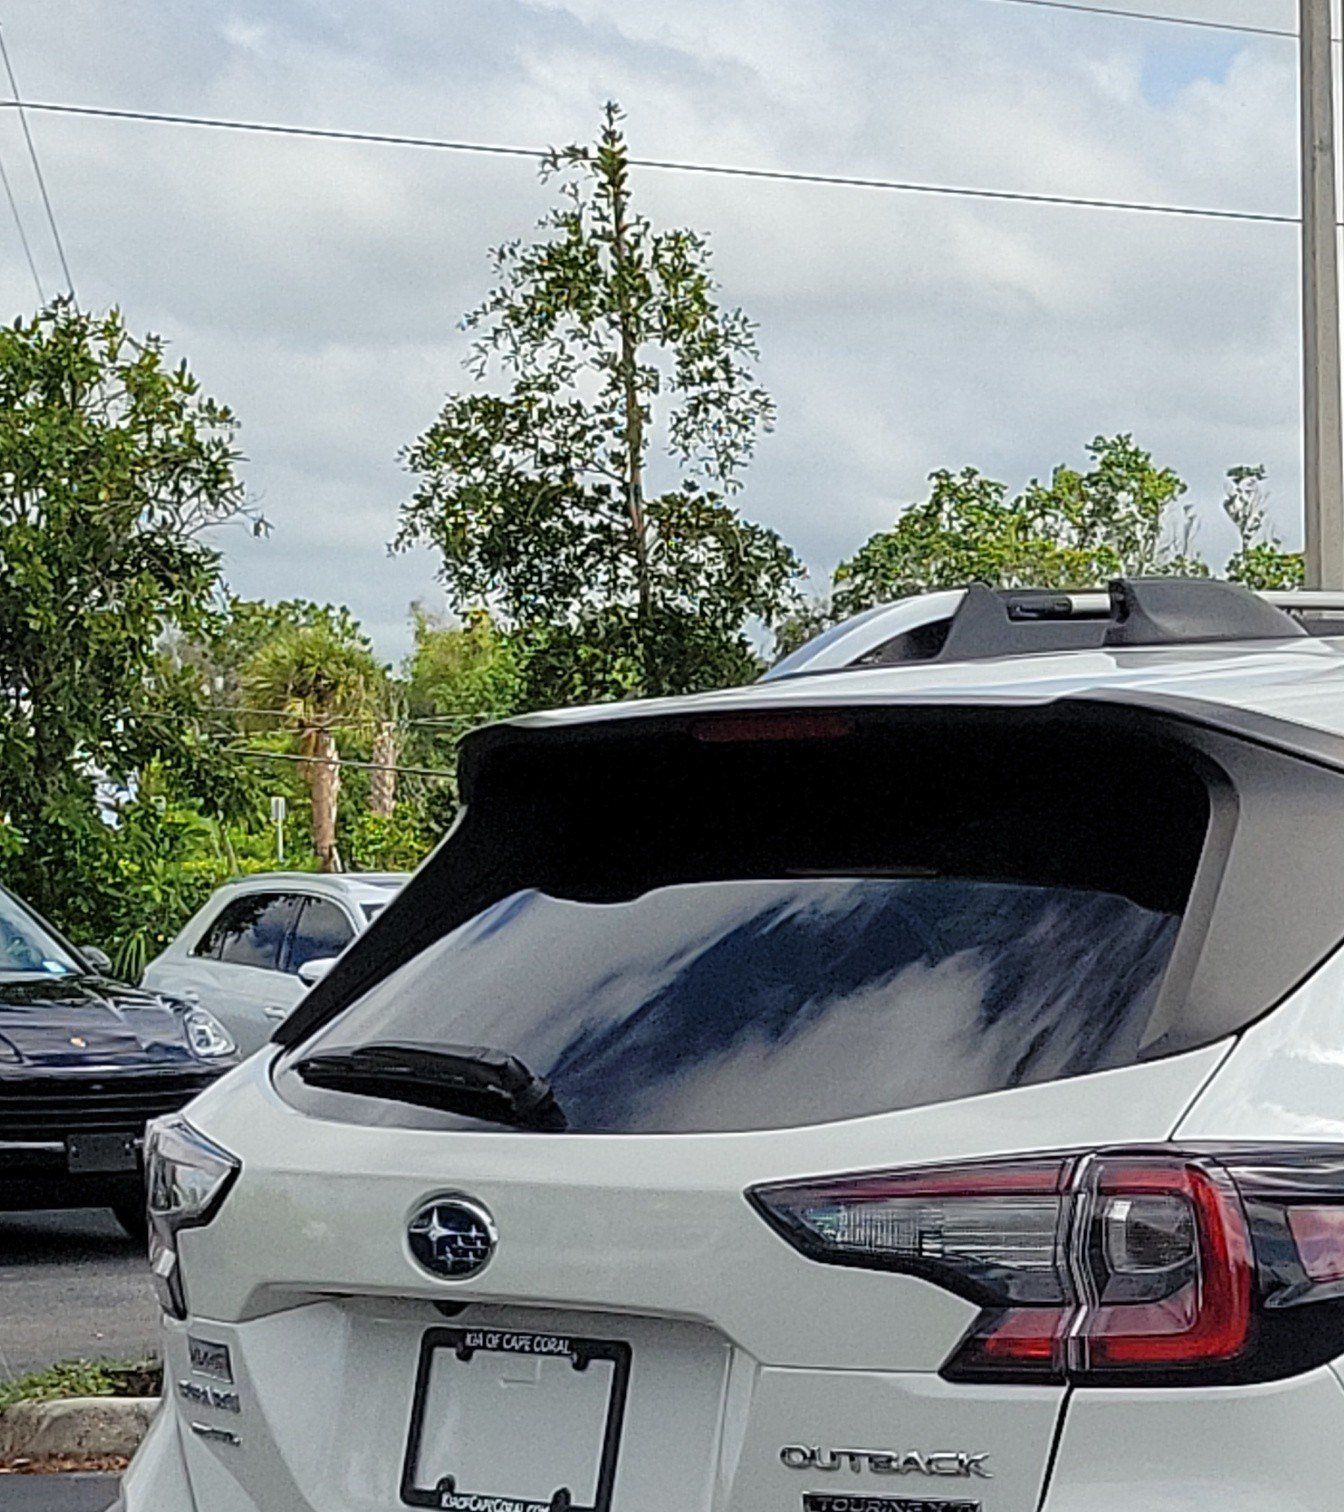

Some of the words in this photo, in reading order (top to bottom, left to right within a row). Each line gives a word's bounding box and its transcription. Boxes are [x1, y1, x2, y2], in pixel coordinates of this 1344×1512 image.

[485, 1333, 502, 1348] OF
[502, 1334, 532, 1351] CAPE
[533, 1335, 572, 1354] CORAL
[780, 1444, 994, 1478] OUTBACK
